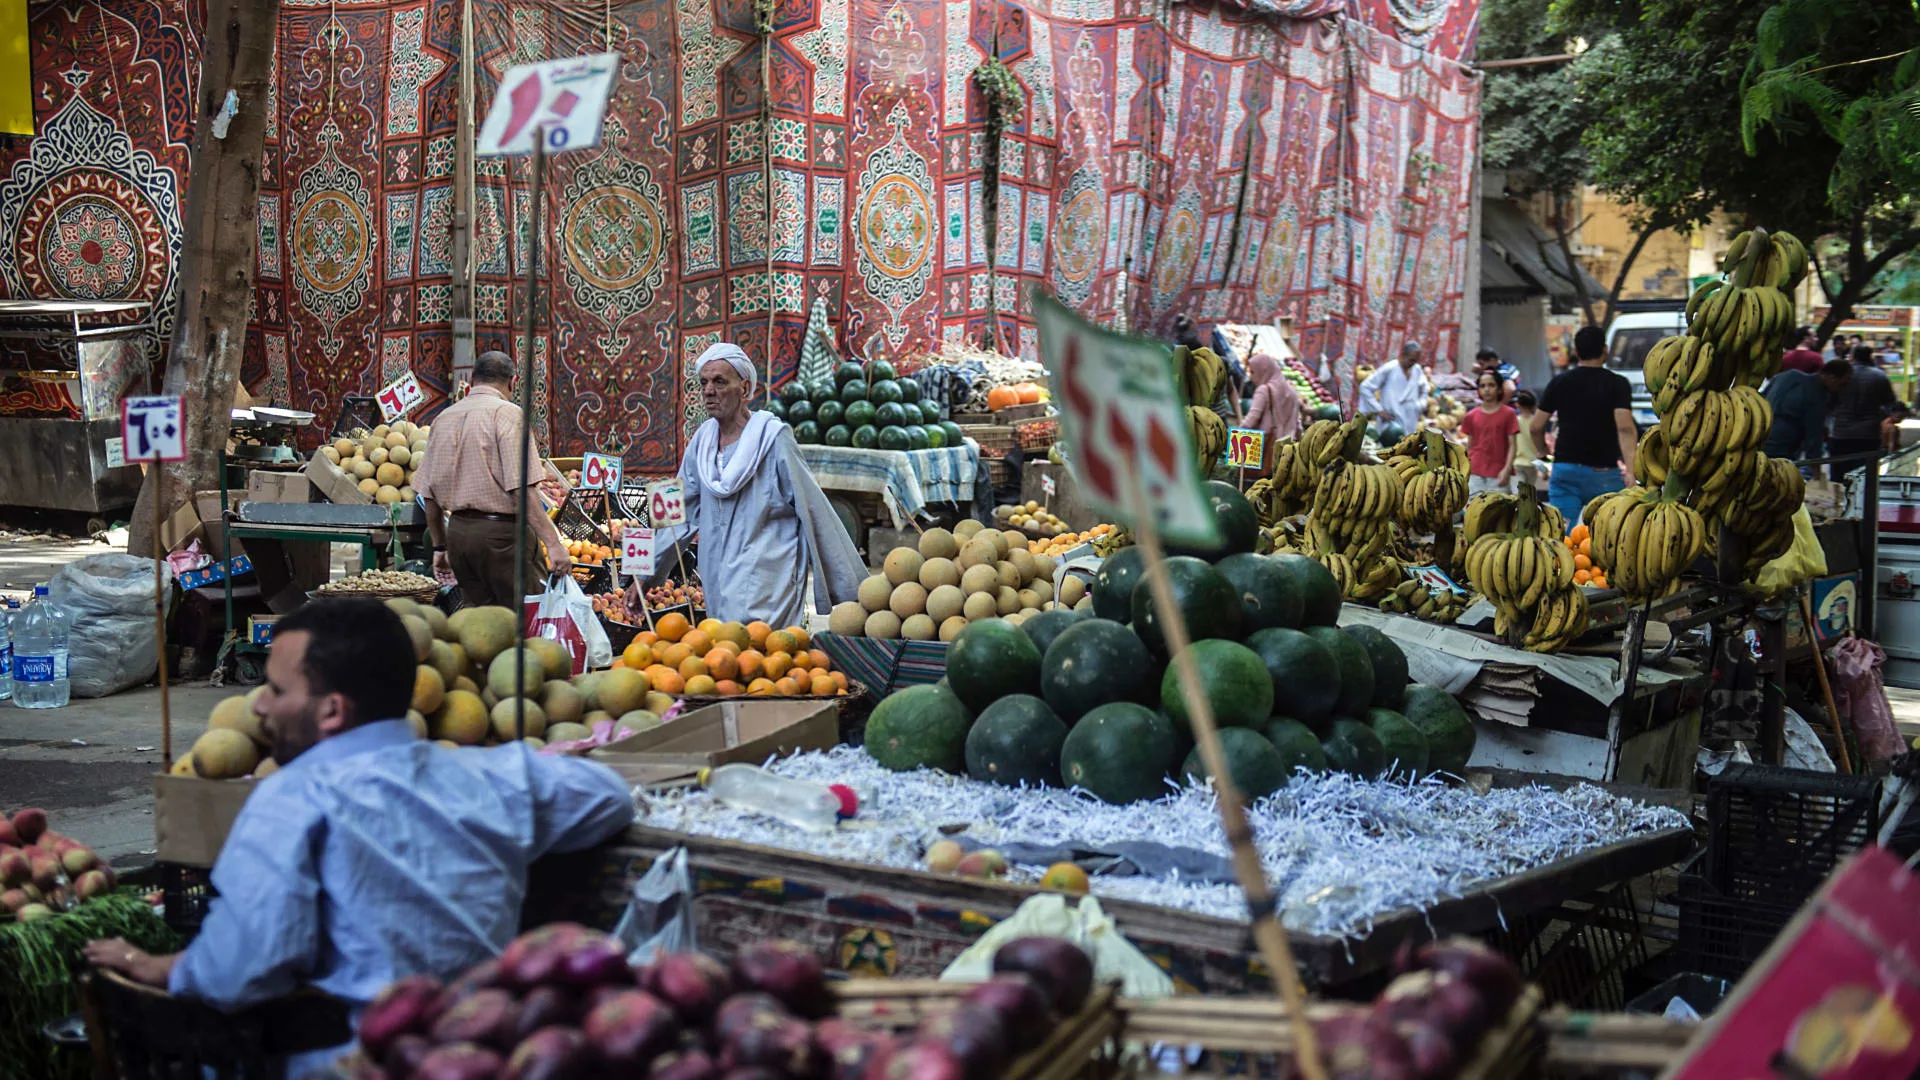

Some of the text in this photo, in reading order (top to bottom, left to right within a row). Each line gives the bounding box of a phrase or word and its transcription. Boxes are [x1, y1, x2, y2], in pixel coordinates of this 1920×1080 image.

[587, 457, 617, 485] ٥٠٠
[652, 493, 680, 520] ٥٠٠
[627, 543, 648, 558] ٥٠٠
[22, 663, 52, 676] AQUAFINA
